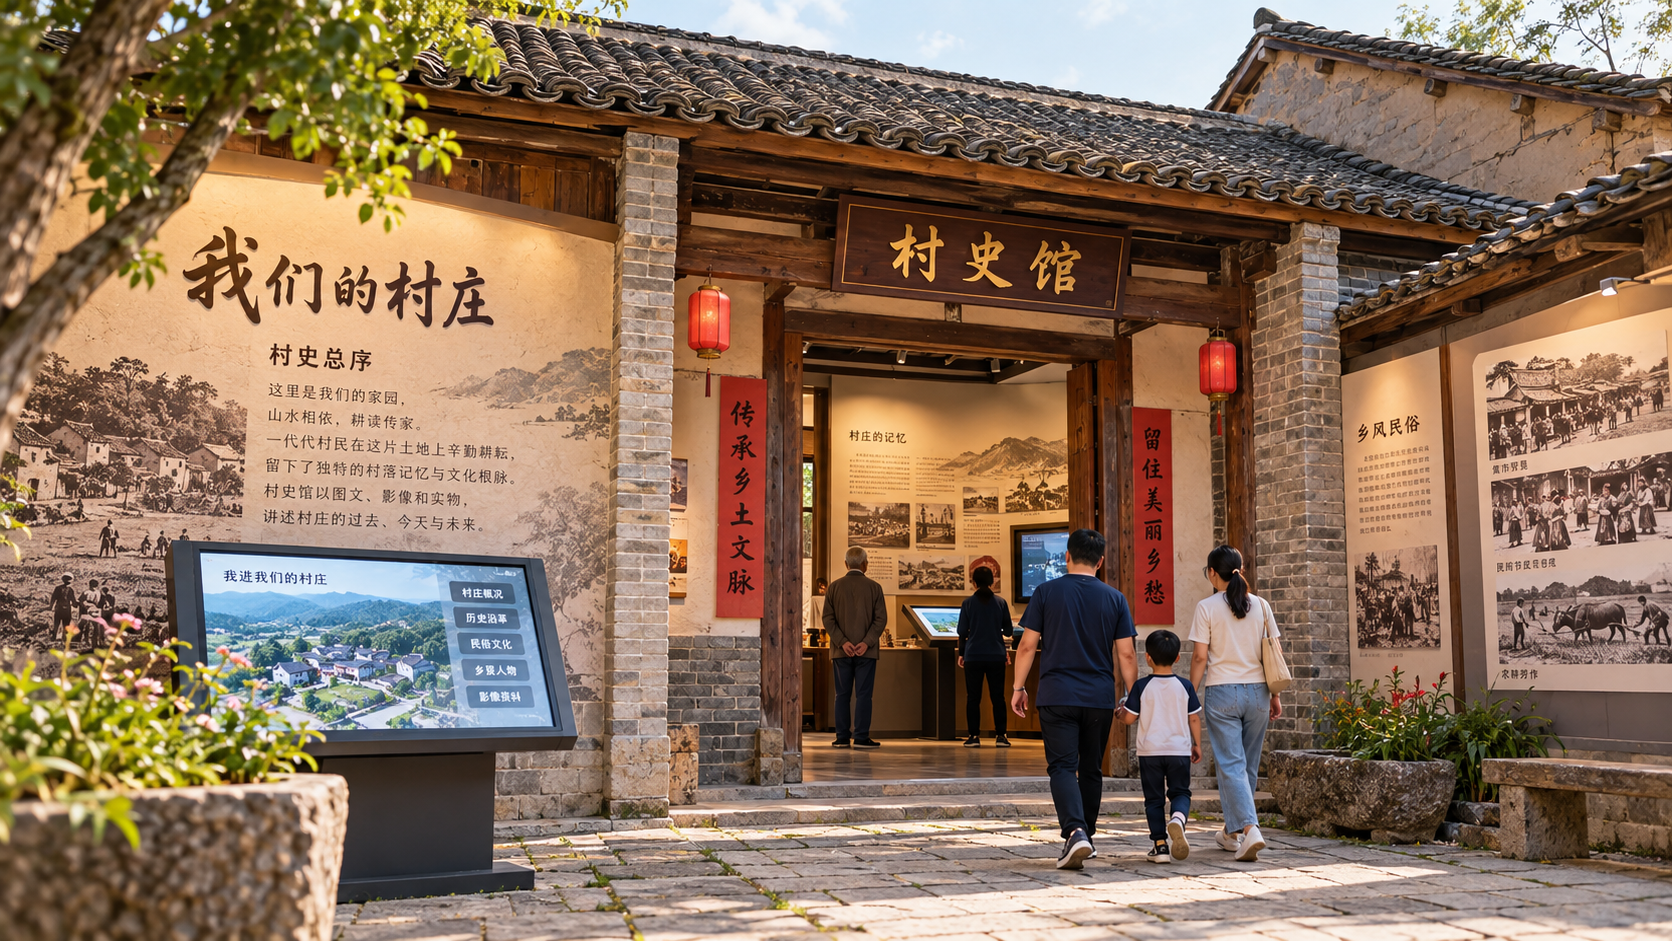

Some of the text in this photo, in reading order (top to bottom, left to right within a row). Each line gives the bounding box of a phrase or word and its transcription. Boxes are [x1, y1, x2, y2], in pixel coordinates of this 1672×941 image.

[890, 224, 1081, 294] 村史馆
[183, 226, 494, 328] 我们的村庄
[269, 343, 372, 371] 村史总序
[268, 382, 405, 406] 这里是我们的家园，
[268, 407, 422, 431] 山水相依，耕读传家。
[1357, 415, 1420, 443] 乡风民俗
[849, 430, 907, 444] 村庄的记忆
[266, 457, 515, 485] 留下了独特的村落记忆与文化根脉。
[727, 400, 757, 596] 传承乡土文脉
[263, 509, 483, 532] 讲述村庄的过去、今天与未来。
[1142, 427, 1165, 605] 留住美丽乡愁
[470, 638, 512, 650] 民俗文化
